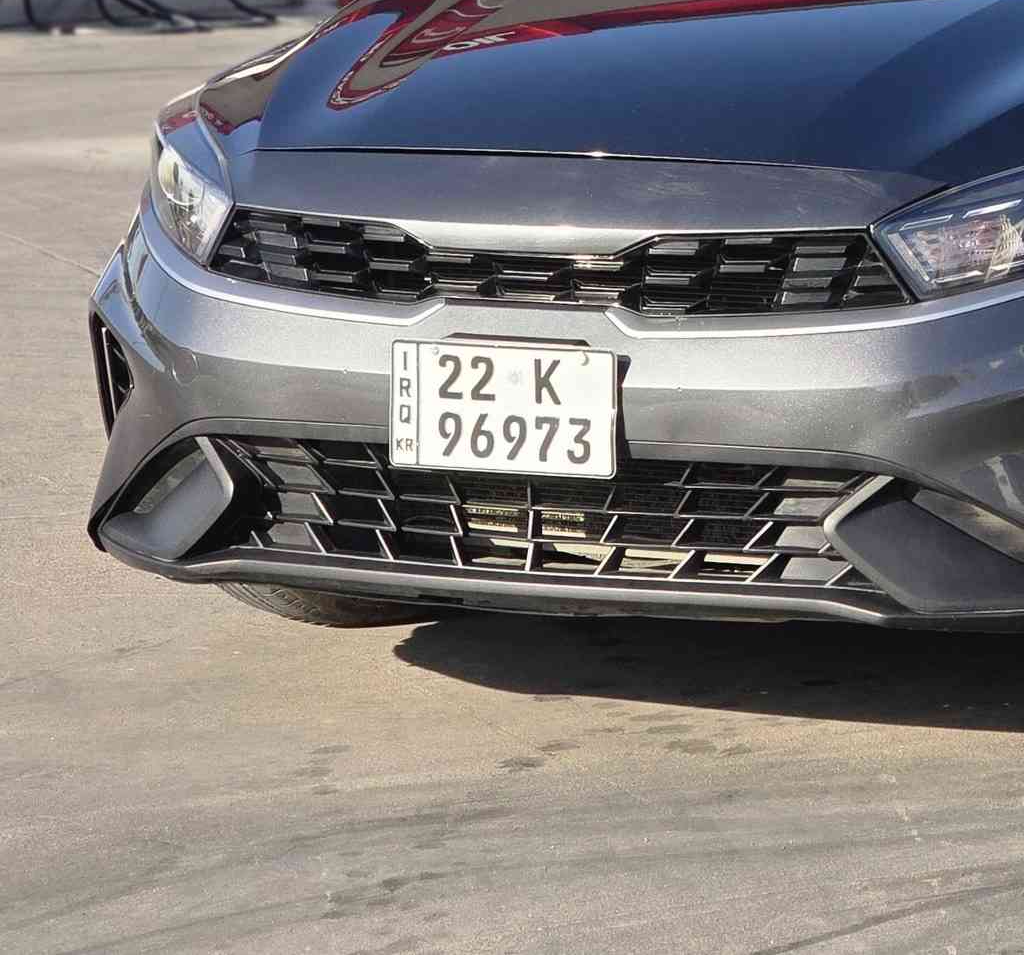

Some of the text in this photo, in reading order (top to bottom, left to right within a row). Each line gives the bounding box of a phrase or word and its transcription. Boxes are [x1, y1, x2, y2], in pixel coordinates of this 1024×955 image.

[438, 354, 561, 405] 22 K
[395, 438, 414, 452] KR
[438, 411, 591, 465] 96973
